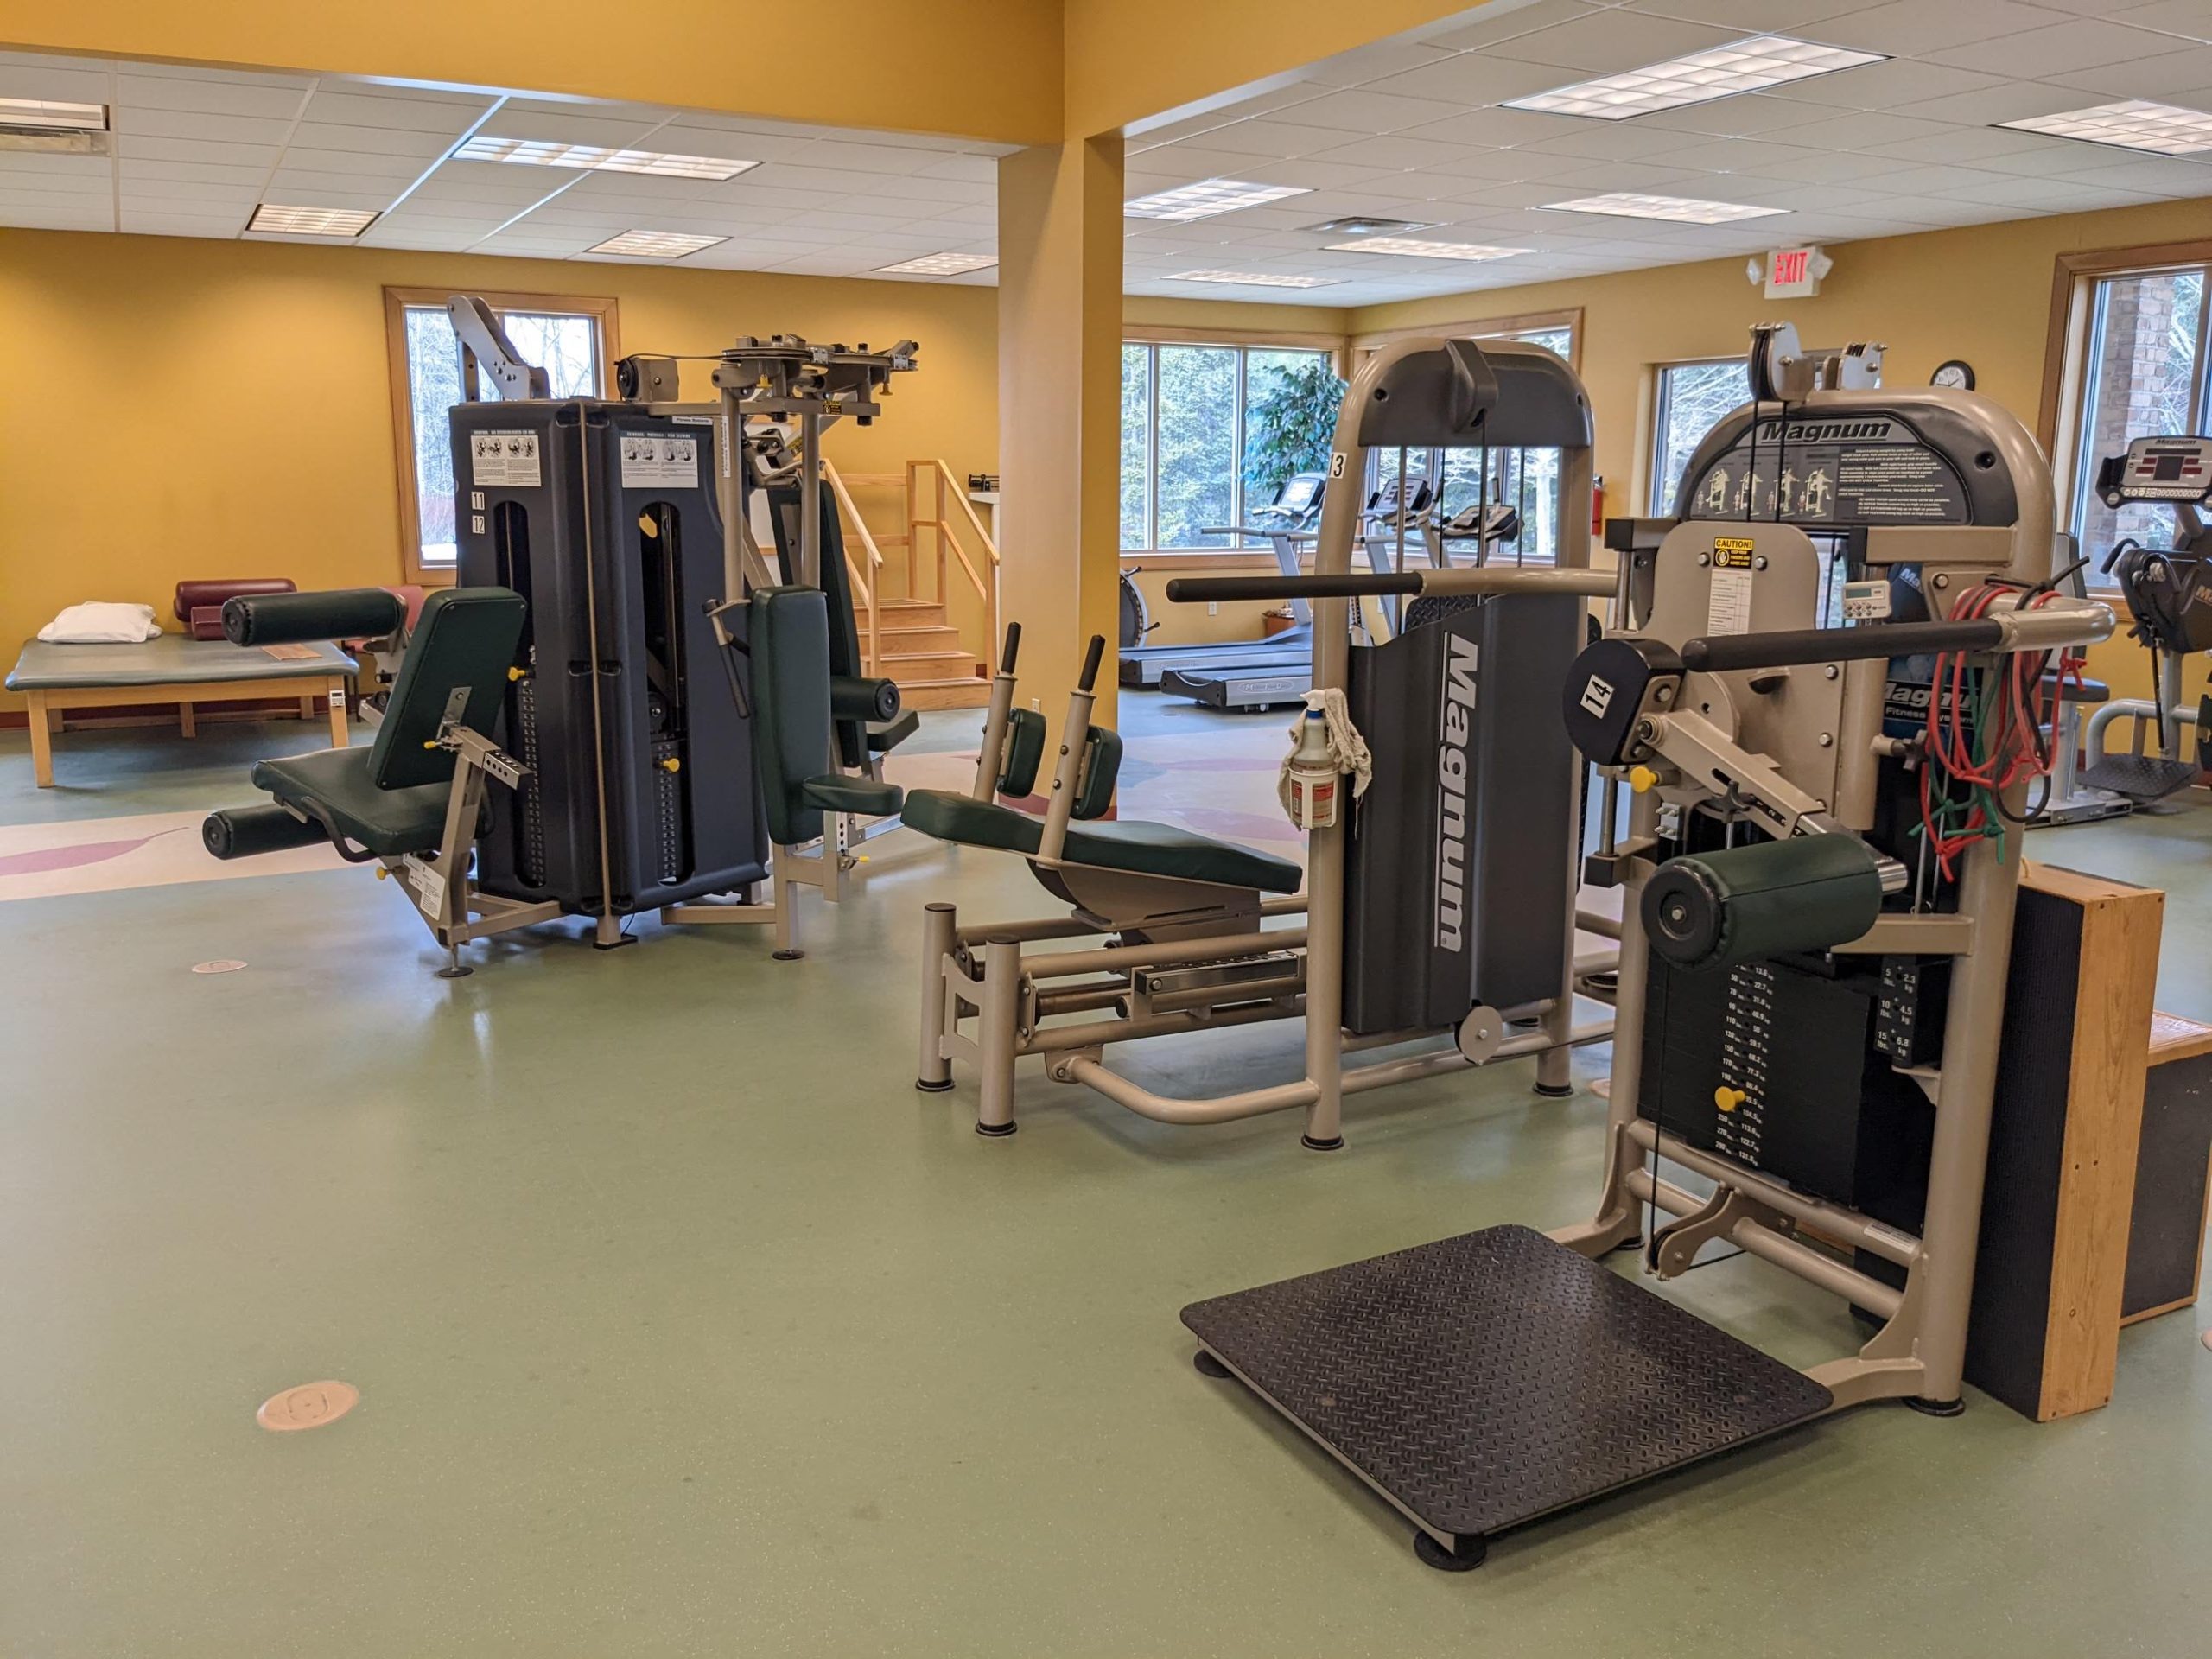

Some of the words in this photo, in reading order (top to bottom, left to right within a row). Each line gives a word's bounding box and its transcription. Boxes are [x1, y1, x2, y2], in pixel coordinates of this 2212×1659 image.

[1774, 251, 1808, 285] EXIT
[1762, 422, 1891, 443] Magnum
[1329, 454, 1344, 477] 13
[473, 493, 484, 509] 11
[474, 517, 484, 532] 12
[1716, 539, 1751, 550] CAUTION!
[1586, 681, 1611, 709] 14
[1885, 706, 1926, 719] Fitness
[1438, 632, 1479, 953] Magnum
[1885, 968, 1891, 976] 5
[1904, 973, 1916, 984] 2.3
[1754, 982, 1766, 990] 22.7
[1904, 984, 1913, 994] kg
[1881, 1000, 1891, 1009] 10
[1900, 1005, 1912, 1015] 4.5
[1726, 1015, 1736, 1025] 110
[1901, 1015, 1910, 1025] kg
[1878, 1031, 1887, 1040] 15
[1897, 1037, 1909, 1047] 6.8
[1723, 1058, 1732, 1066] 170
